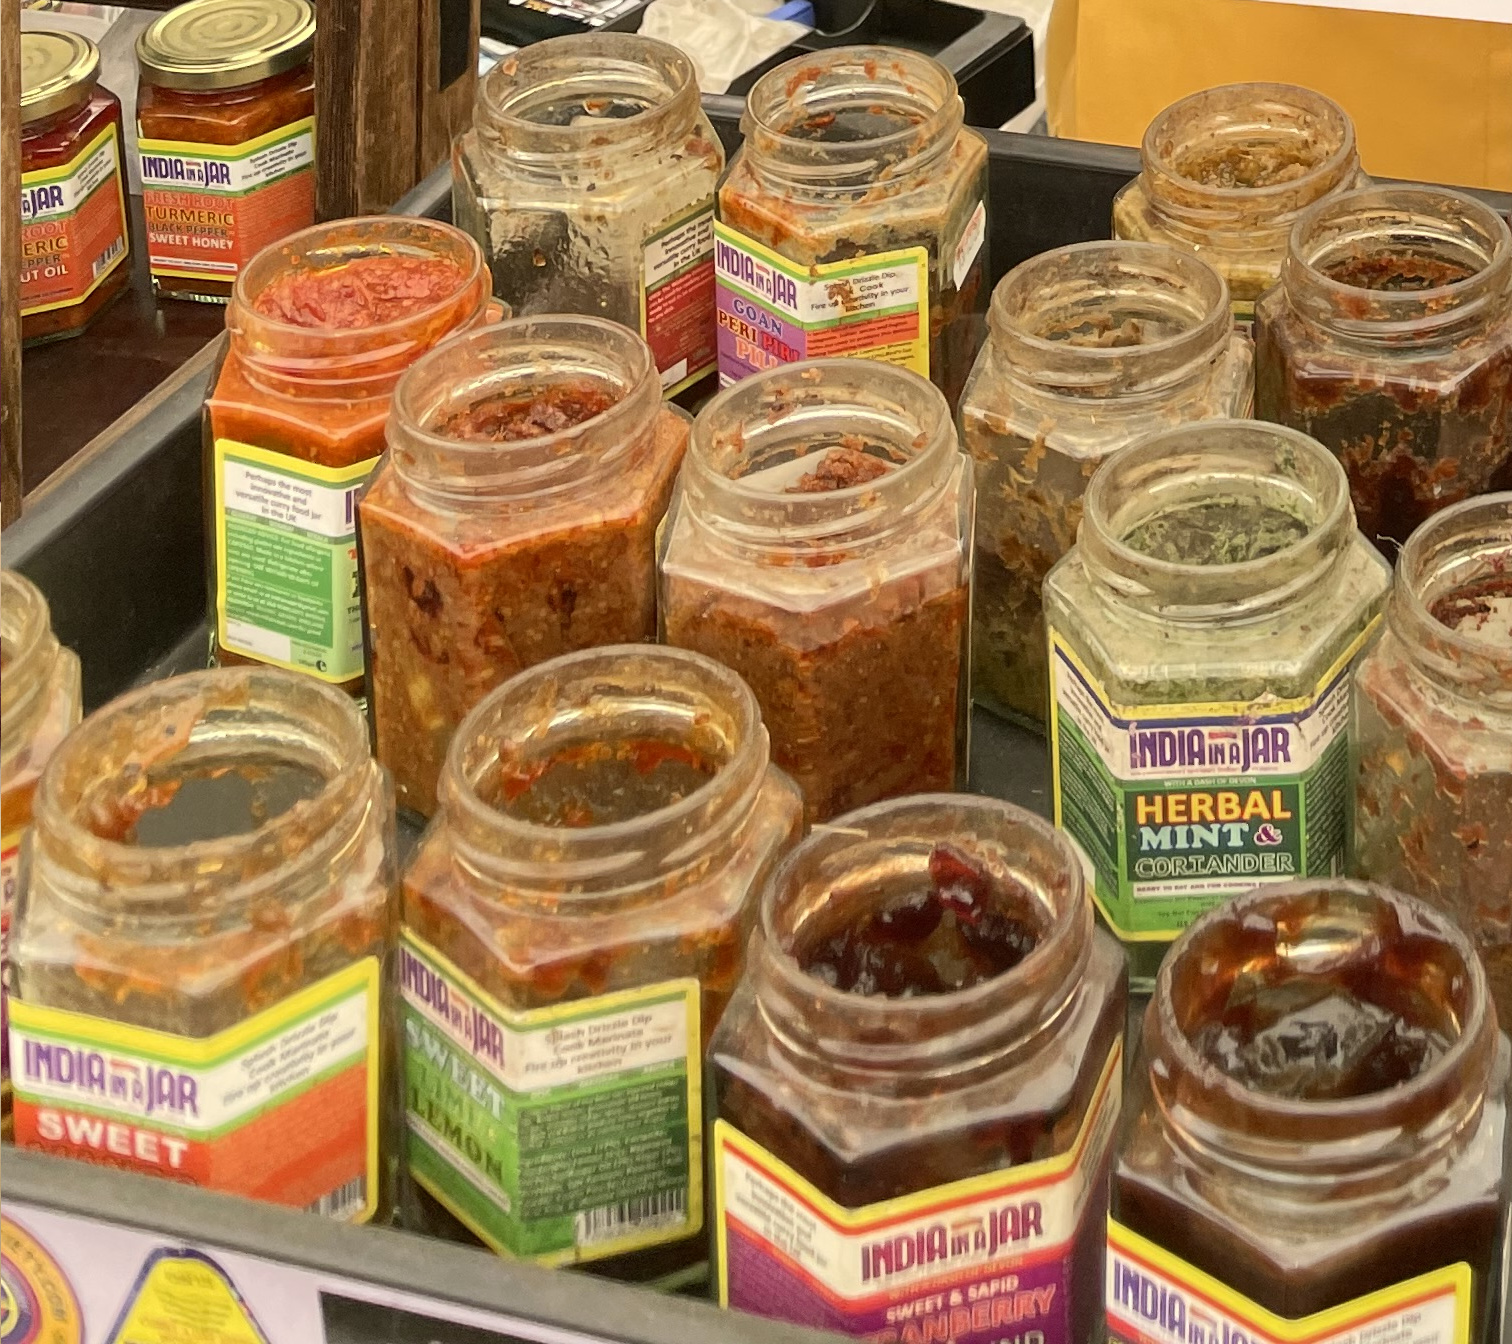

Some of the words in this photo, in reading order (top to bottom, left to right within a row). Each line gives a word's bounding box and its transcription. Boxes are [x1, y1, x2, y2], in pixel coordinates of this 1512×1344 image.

[142, 156, 184, 180] INDIA
[203, 160, 232, 188] JAR
[31, 185, 64, 220] JAR
[145, 193, 193, 208] FRESH
[195, 195, 235, 210] ROOT
[146, 206, 234, 226] TURMERIC
[148, 223, 183, 235] BLACK
[185, 225, 228, 238] PEPPER
[149, 232, 190, 247] SWEET
[192, 235, 234, 250] HONEY
[46, 265, 69, 278] OIL
[716, 240, 755, 288] INDIA
[772, 269, 798, 310] JAR
[718, 310, 757, 343] PERI
[761, 333, 801, 362] PIRI
[733, 299, 782, 337] GOAN
[1129, 728, 1206, 769] INDIA
[1208, 743, 1226, 766] IN
[1229, 742, 1240, 766] A
[1240, 726, 1291, 773] JAR
[1136, 789, 1293, 825] HERBAL
[1139, 822, 1250, 851] MINT
[1253, 823, 1283, 847] &
[1135, 852, 1295, 879] CORIANDER
[400, 947, 449, 1021] INDIA
[472, 1006, 505, 1070] JAR
[23, 1040, 105, 1092] INDIA
[146, 1065, 199, 1117] JAR
[36, 1109, 189, 1169] SWEET
[861, 1226, 948, 1284] INDIA
[987, 1201, 1043, 1257] JAR
[886, 1293, 945, 1324] SWEET
[967, 1274, 1020, 1302] SAPID
[1114, 1257, 1186, 1340] INDIA
